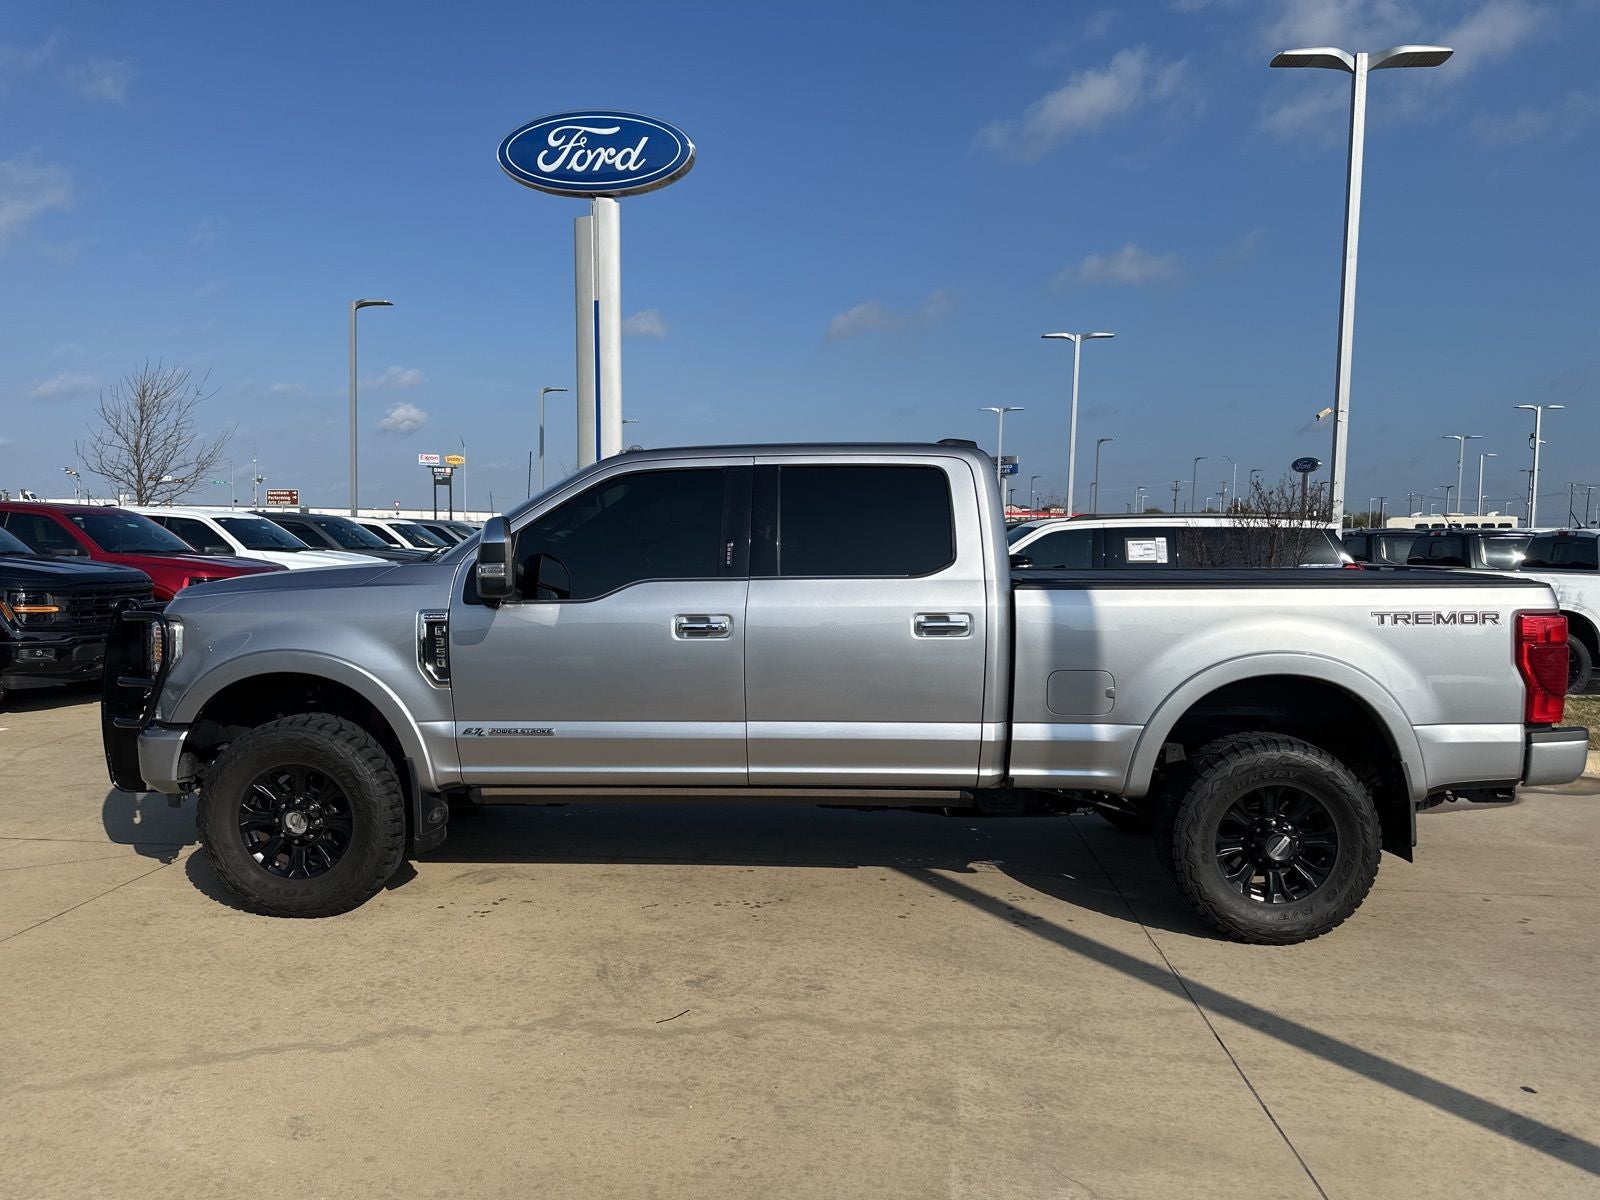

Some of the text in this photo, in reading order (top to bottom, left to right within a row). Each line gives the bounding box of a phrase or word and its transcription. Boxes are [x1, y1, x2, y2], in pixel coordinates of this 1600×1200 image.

[537, 125, 649, 172] Ford
[420, 454, 439, 462] Exxon
[1370, 611, 1502, 626] TREMOR
